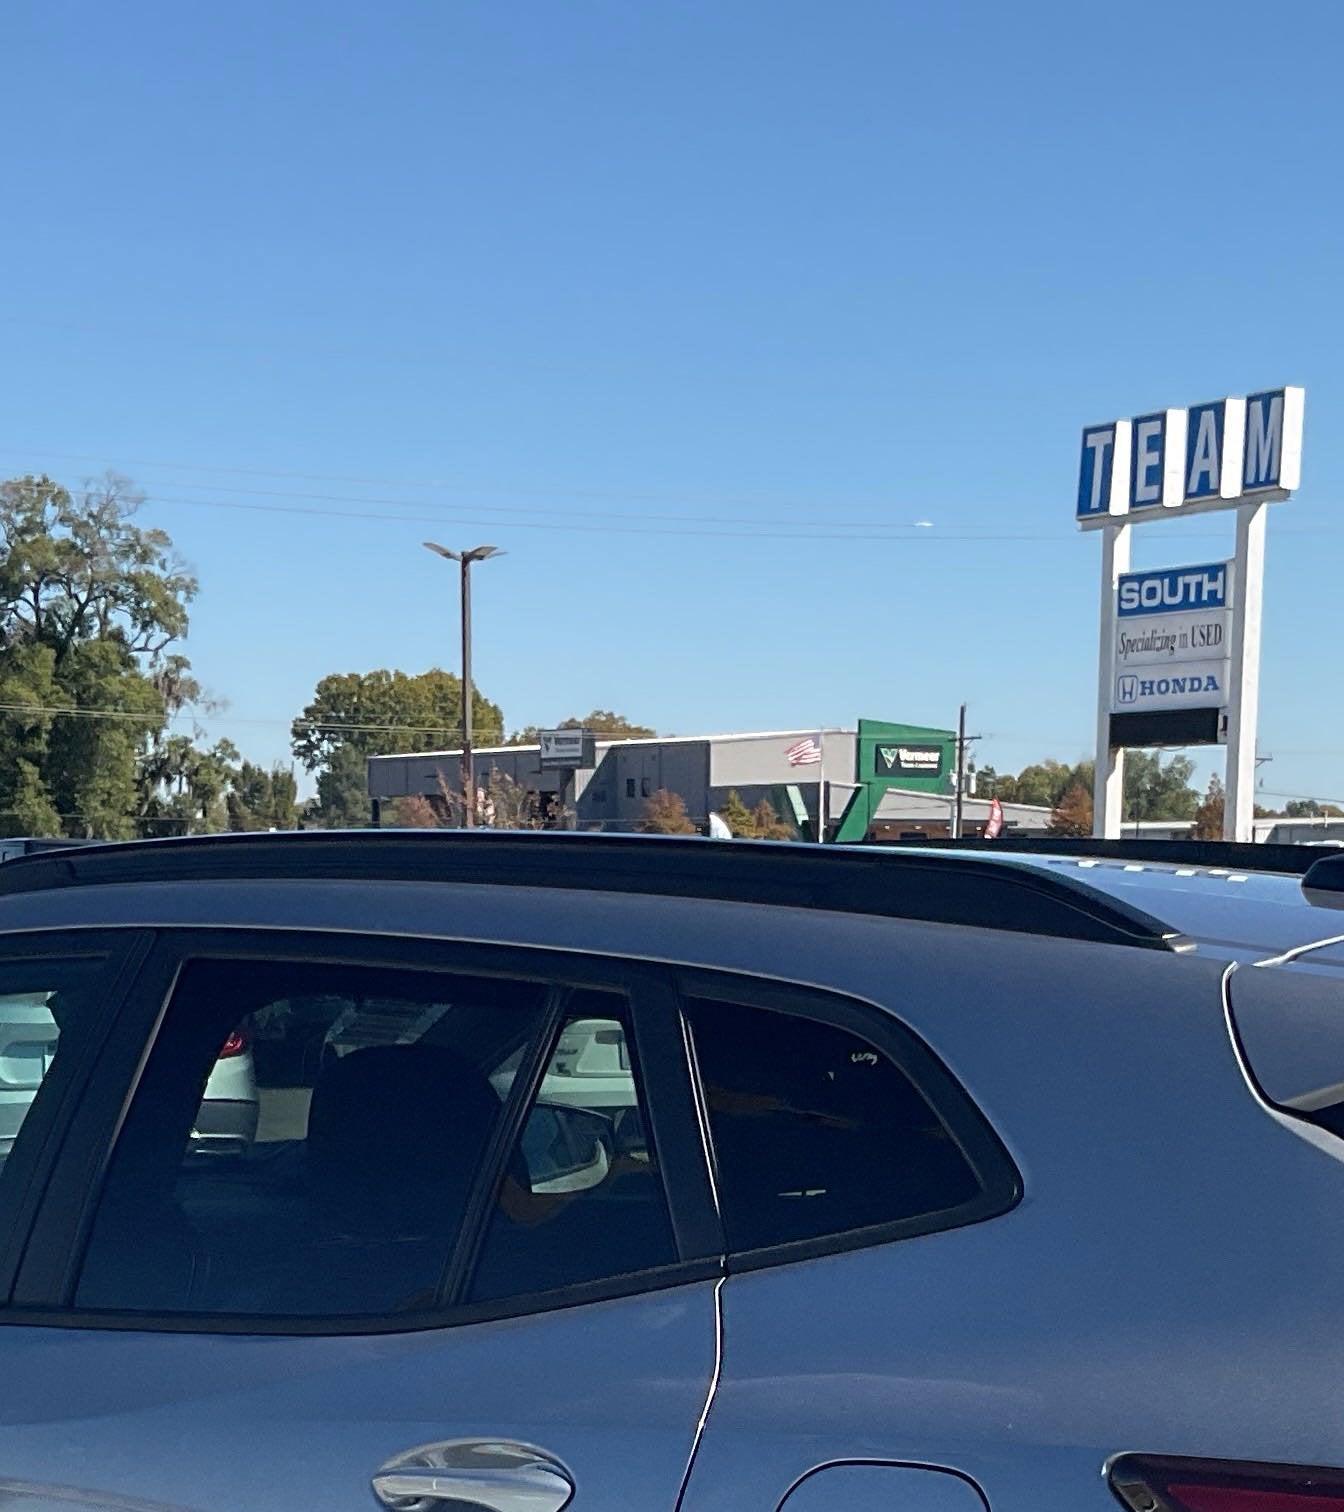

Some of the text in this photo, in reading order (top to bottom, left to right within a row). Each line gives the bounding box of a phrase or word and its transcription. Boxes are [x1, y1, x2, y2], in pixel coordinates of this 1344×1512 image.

[1085, 396, 1283, 510] TEAM
[1120, 571, 1224, 610] SOUTH
[1119, 623, 1223, 661] Specializing in USED
[1140, 675, 1220, 696] HONDA
